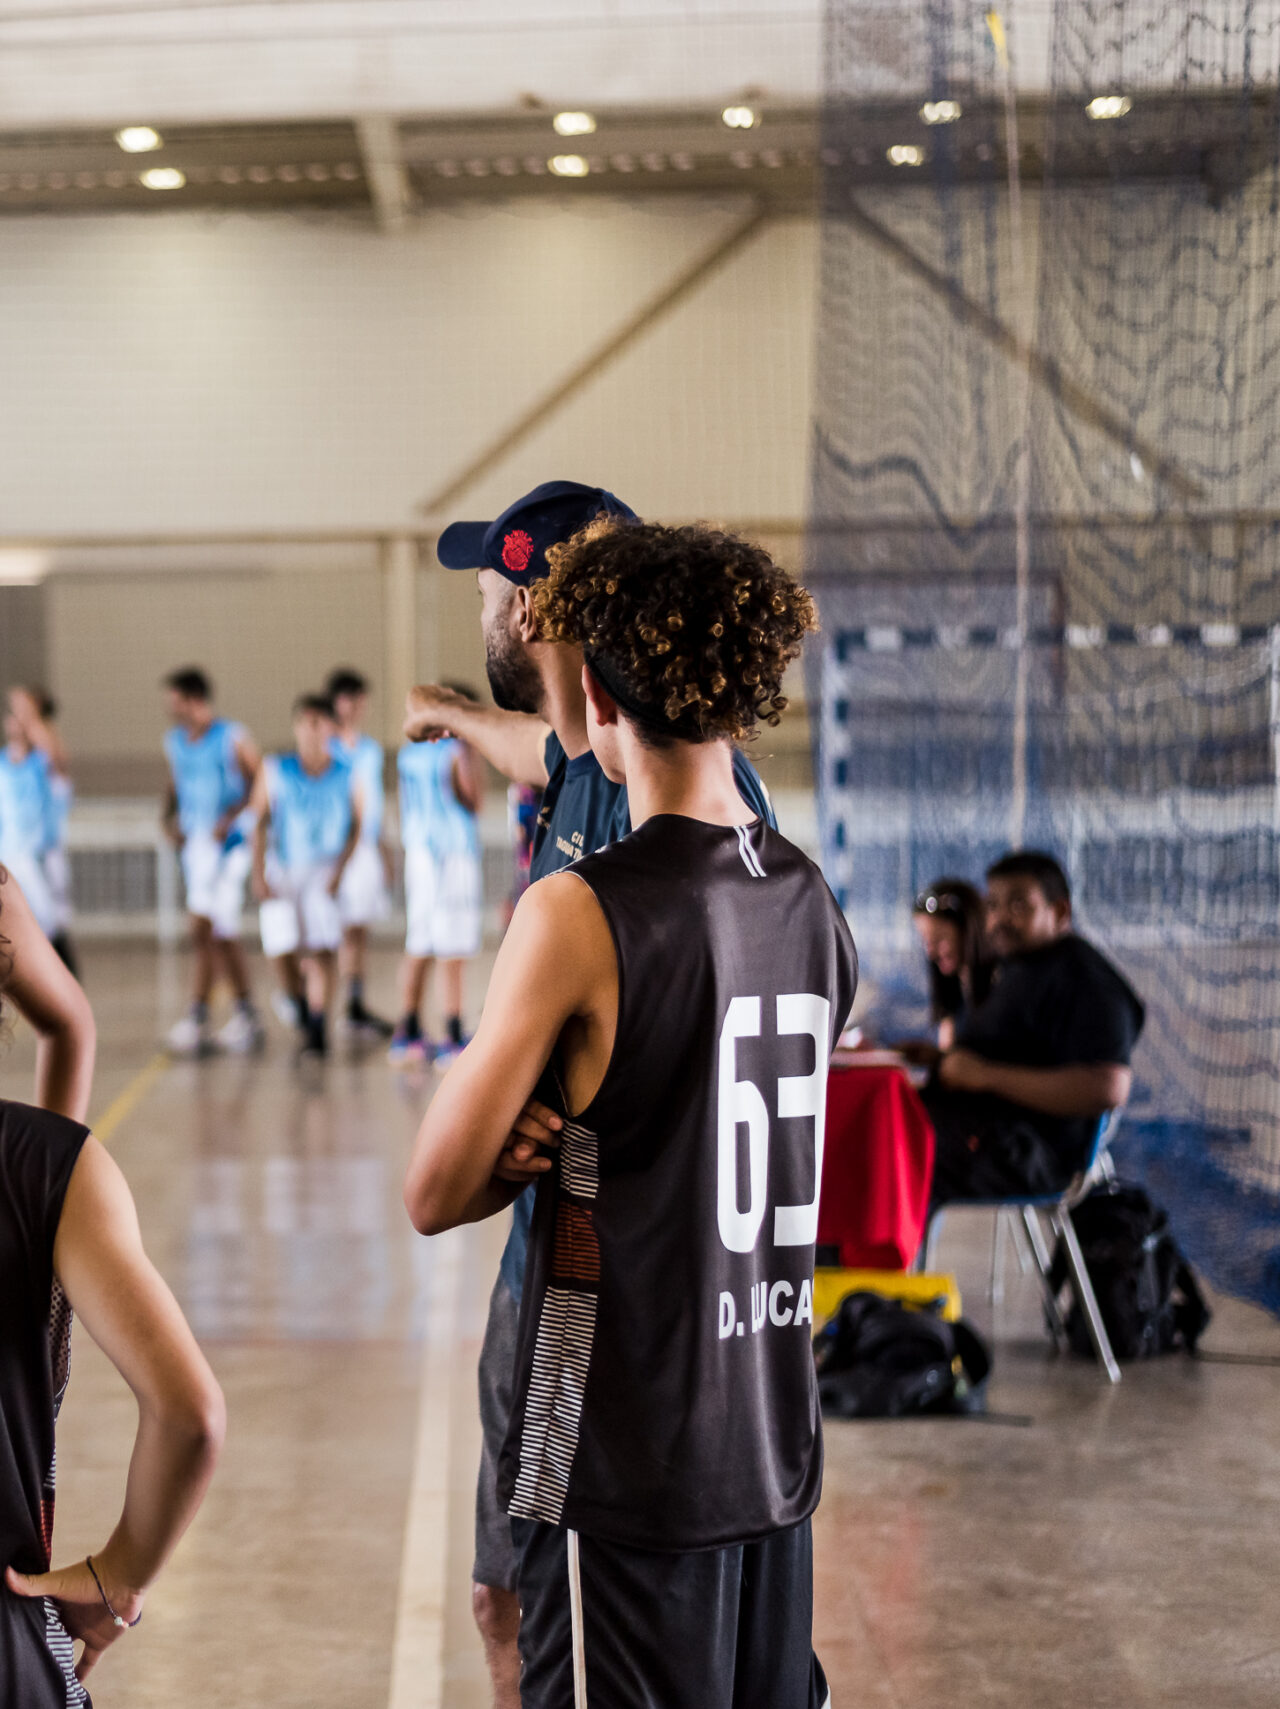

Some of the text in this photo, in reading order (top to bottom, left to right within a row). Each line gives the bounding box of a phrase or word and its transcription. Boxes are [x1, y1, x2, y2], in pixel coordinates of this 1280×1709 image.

[717, 993, 830, 1253] 63
[719, 1279, 815, 1339] D. LUCA
